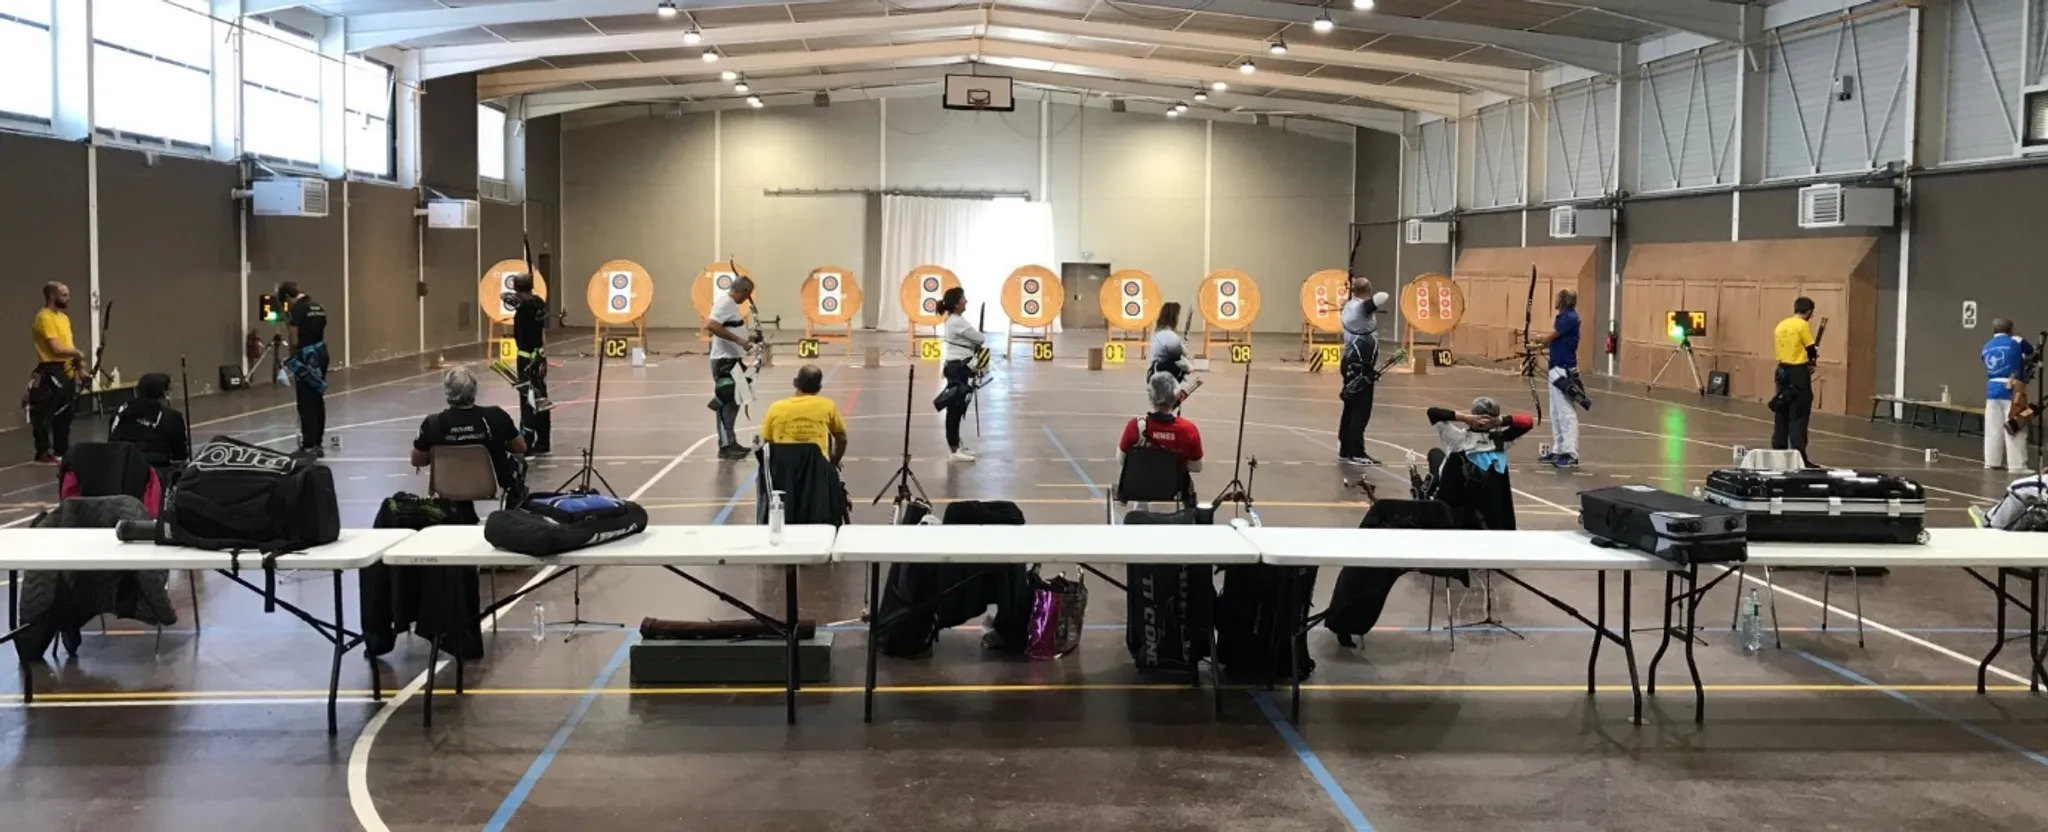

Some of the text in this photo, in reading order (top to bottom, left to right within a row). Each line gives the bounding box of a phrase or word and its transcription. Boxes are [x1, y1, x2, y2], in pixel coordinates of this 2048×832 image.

[501, 341, 511, 357] 0
[606, 340, 626, 357] 02
[799, 341, 818, 357] 04
[921, 342, 941, 358] 05
[1033, 343, 1052, 360] 06
[1105, 344, 1125, 360] 07
[1232, 346, 1251, 361] 08
[1321, 347, 1339, 363] 09
